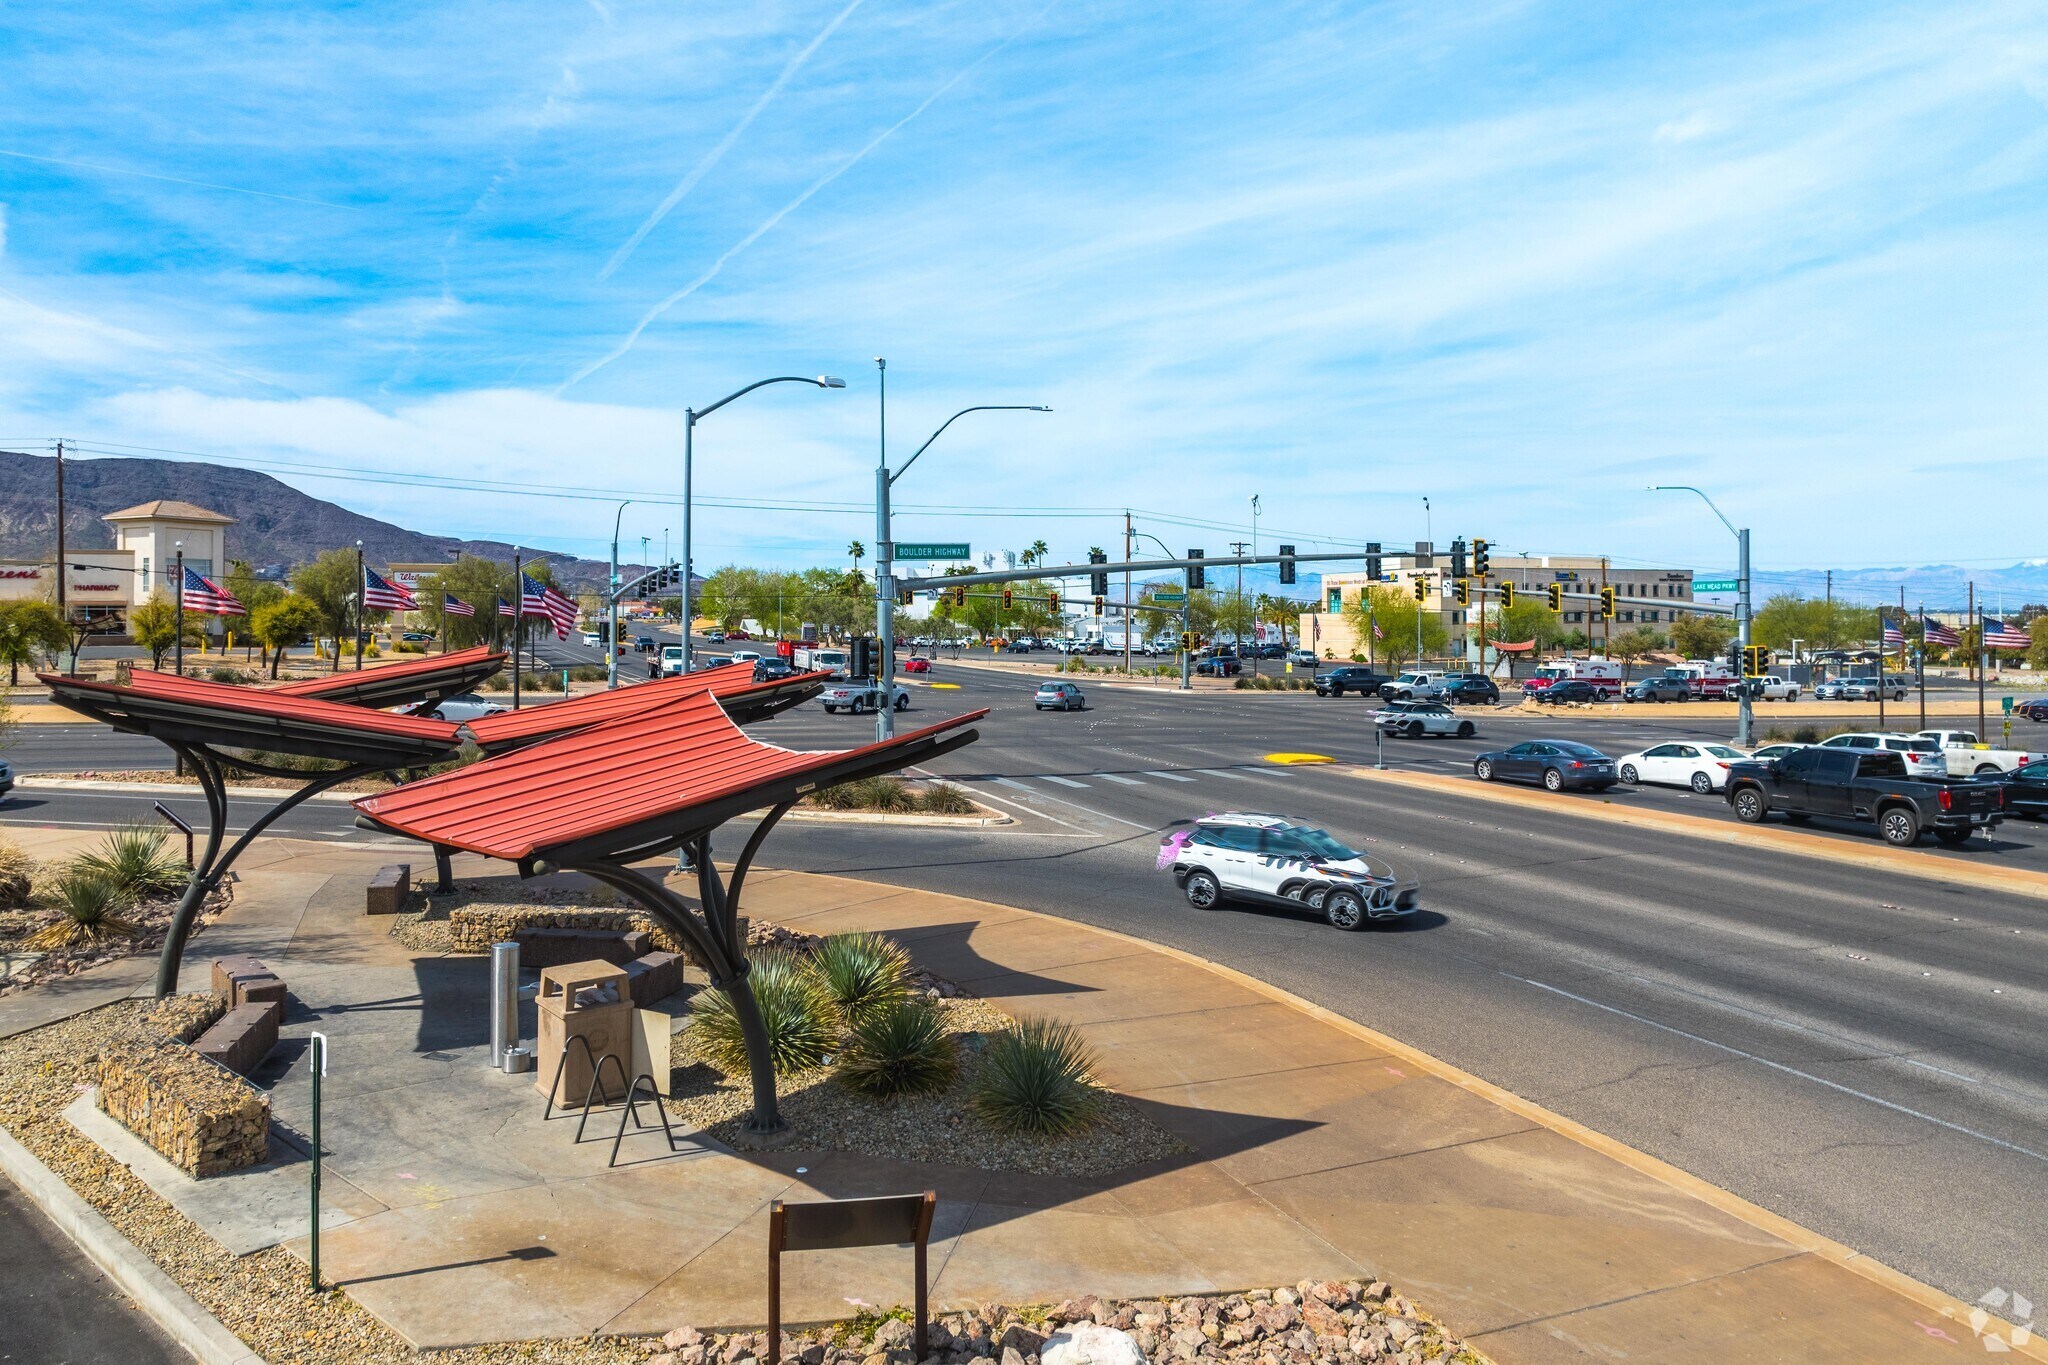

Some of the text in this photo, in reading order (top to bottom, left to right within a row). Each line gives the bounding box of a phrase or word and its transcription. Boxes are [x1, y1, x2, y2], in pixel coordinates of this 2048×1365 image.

[899, 547, 966, 556] BOULDER HIGHWAY
[73, 584, 120, 592] PHARMACY
